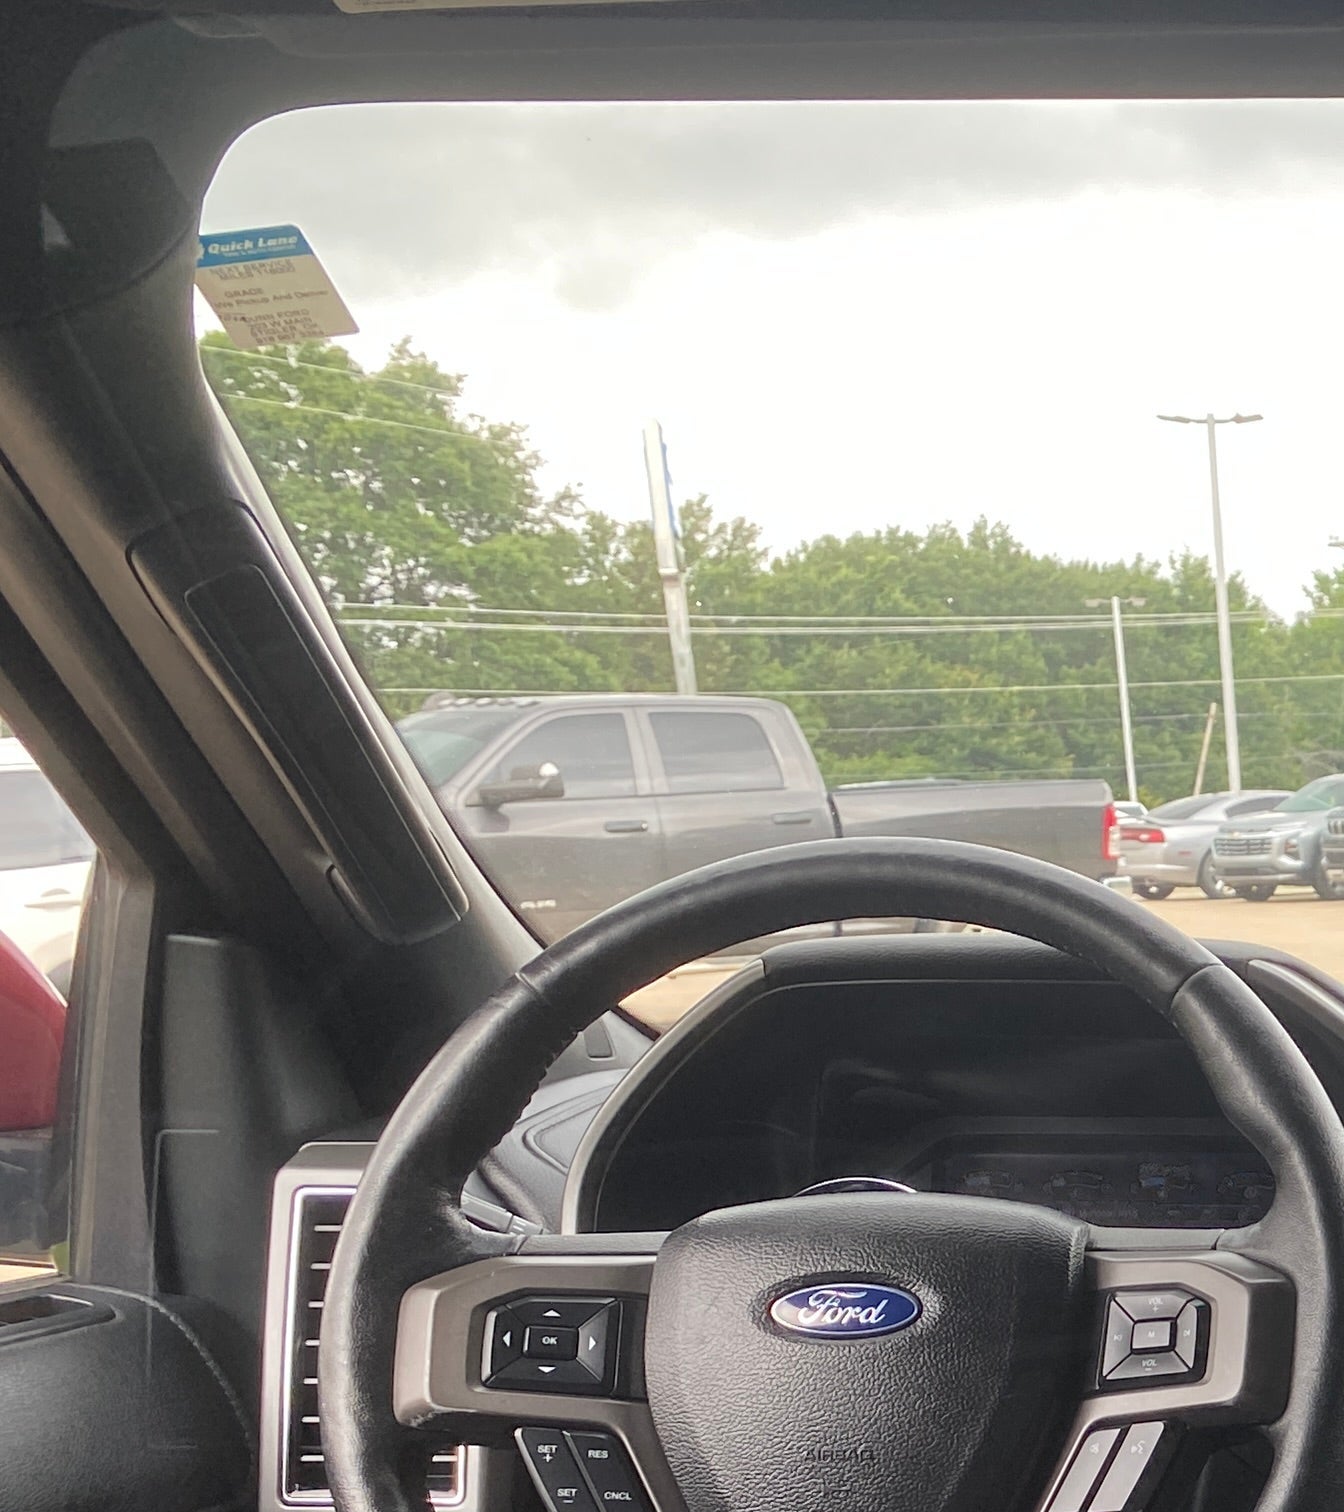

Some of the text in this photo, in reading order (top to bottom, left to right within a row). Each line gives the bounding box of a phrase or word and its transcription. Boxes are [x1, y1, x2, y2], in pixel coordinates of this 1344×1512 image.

[207, 239, 254, 255] Quick
[257, 236, 298, 249] Lane
[797, 1289, 889, 1325] Ford
[541, 1335, 558, 1345] OK
[1141, 1359, 1158, 1367] VOL
[537, 1444, 557, 1454] SET
[588, 1450, 609, 1459] RES
[557, 1488, 578, 1498] SET
[604, 1491, 632, 1501] CNCL
